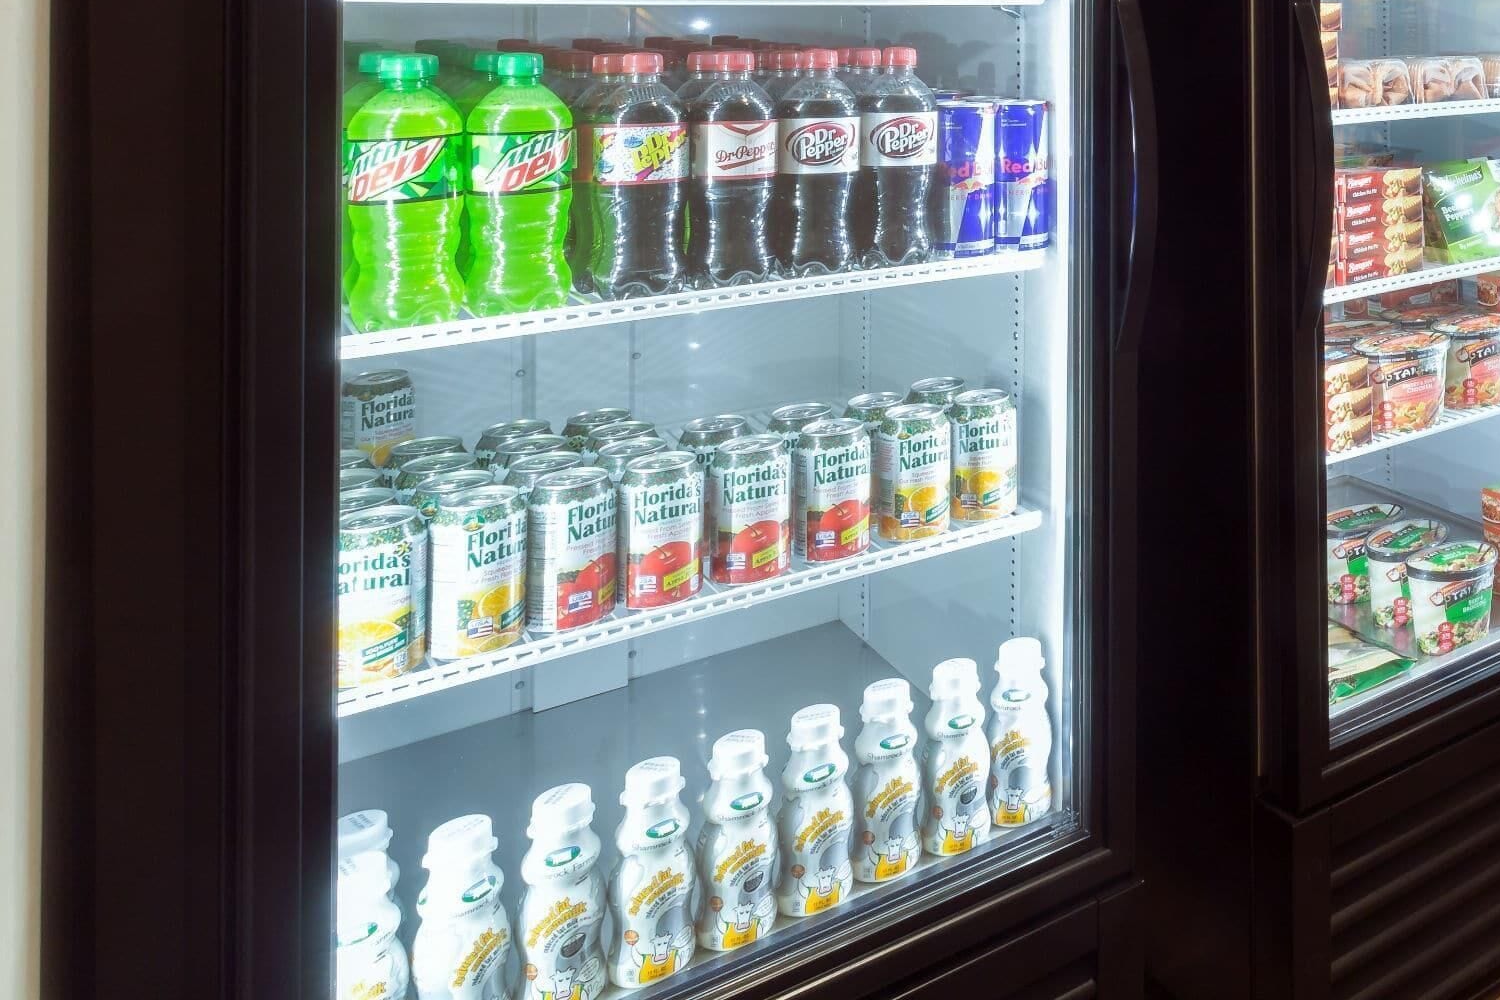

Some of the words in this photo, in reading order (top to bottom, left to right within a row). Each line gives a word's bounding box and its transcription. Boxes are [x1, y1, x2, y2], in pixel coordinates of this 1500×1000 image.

[815, 128, 836, 148] Dr
[898, 123, 919, 135] Dr
[800, 131, 848, 158] Pepper
[884, 125, 929, 153] Pepper
[715, 150, 736, 163] Dr
[1001, 156, 1030, 173] Red
[1478, 345, 1495, 358] TAI
[1394, 367, 1415, 380] TAI
[723, 481, 787, 507] Natural
[634, 500, 700, 527] Natural
